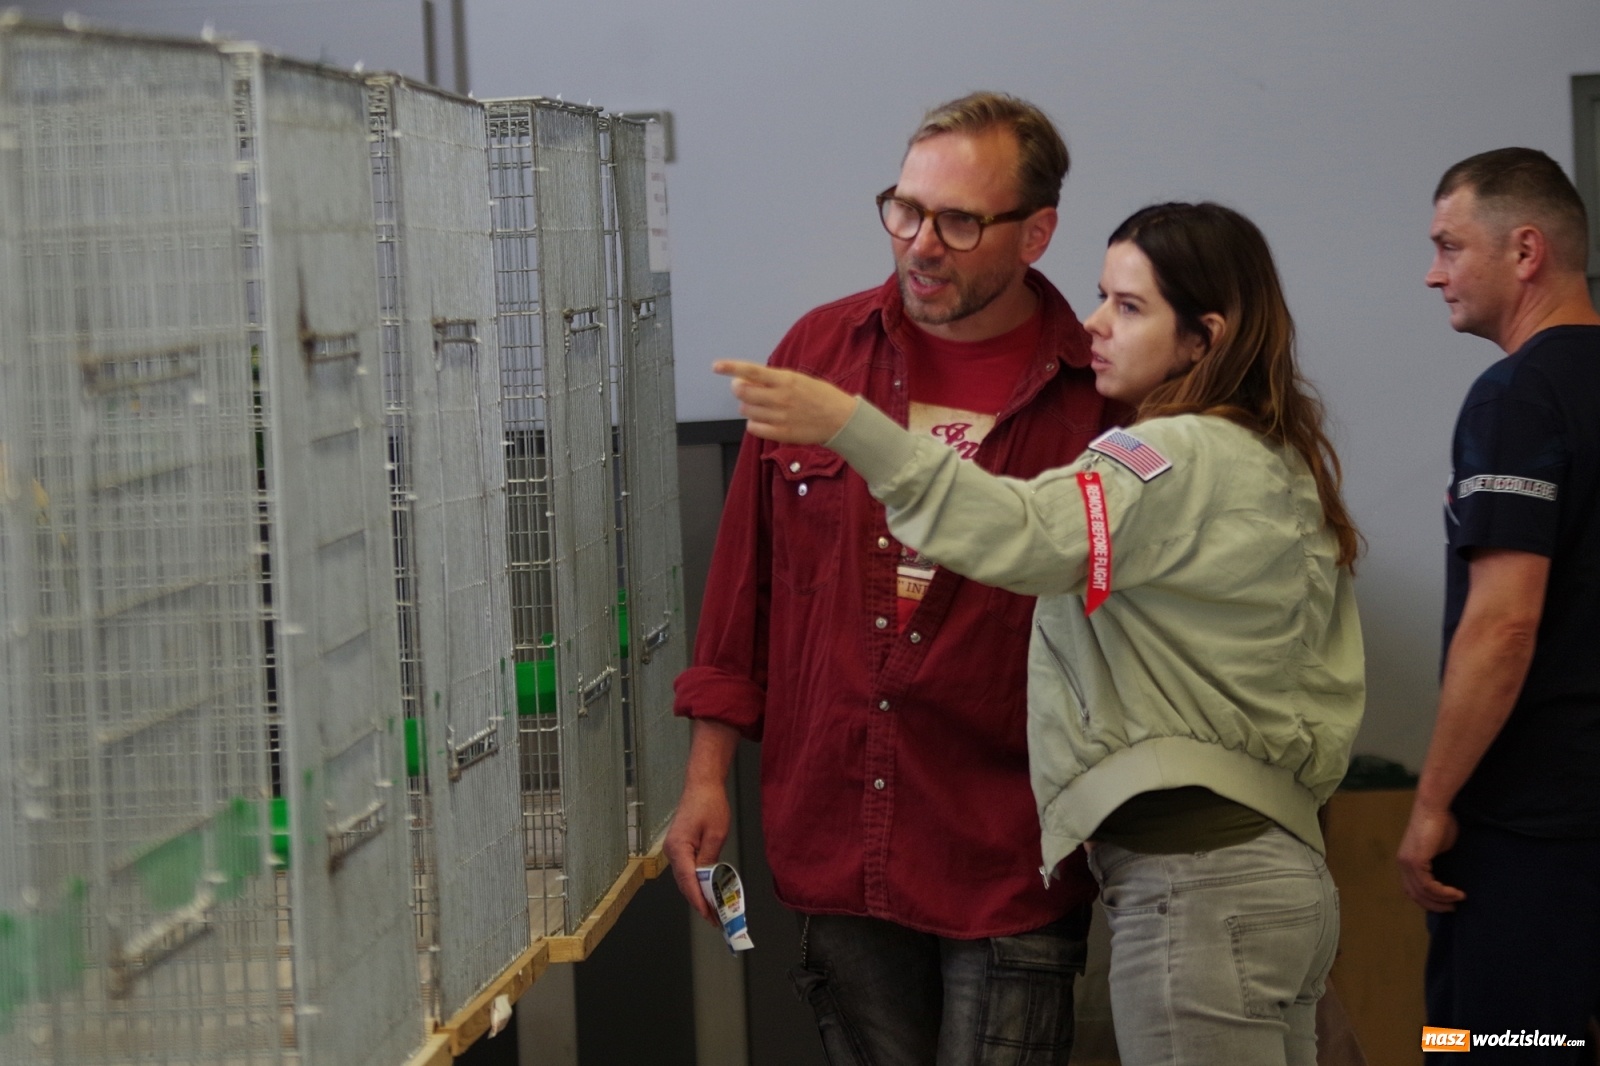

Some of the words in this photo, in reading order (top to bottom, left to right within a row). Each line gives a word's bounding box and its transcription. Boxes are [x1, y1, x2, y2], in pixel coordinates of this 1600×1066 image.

[1085, 484, 1104, 520] REMOVE
[1091, 521, 1107, 556] BEFORE
[1092, 557, 1108, 591] FLIGHT
